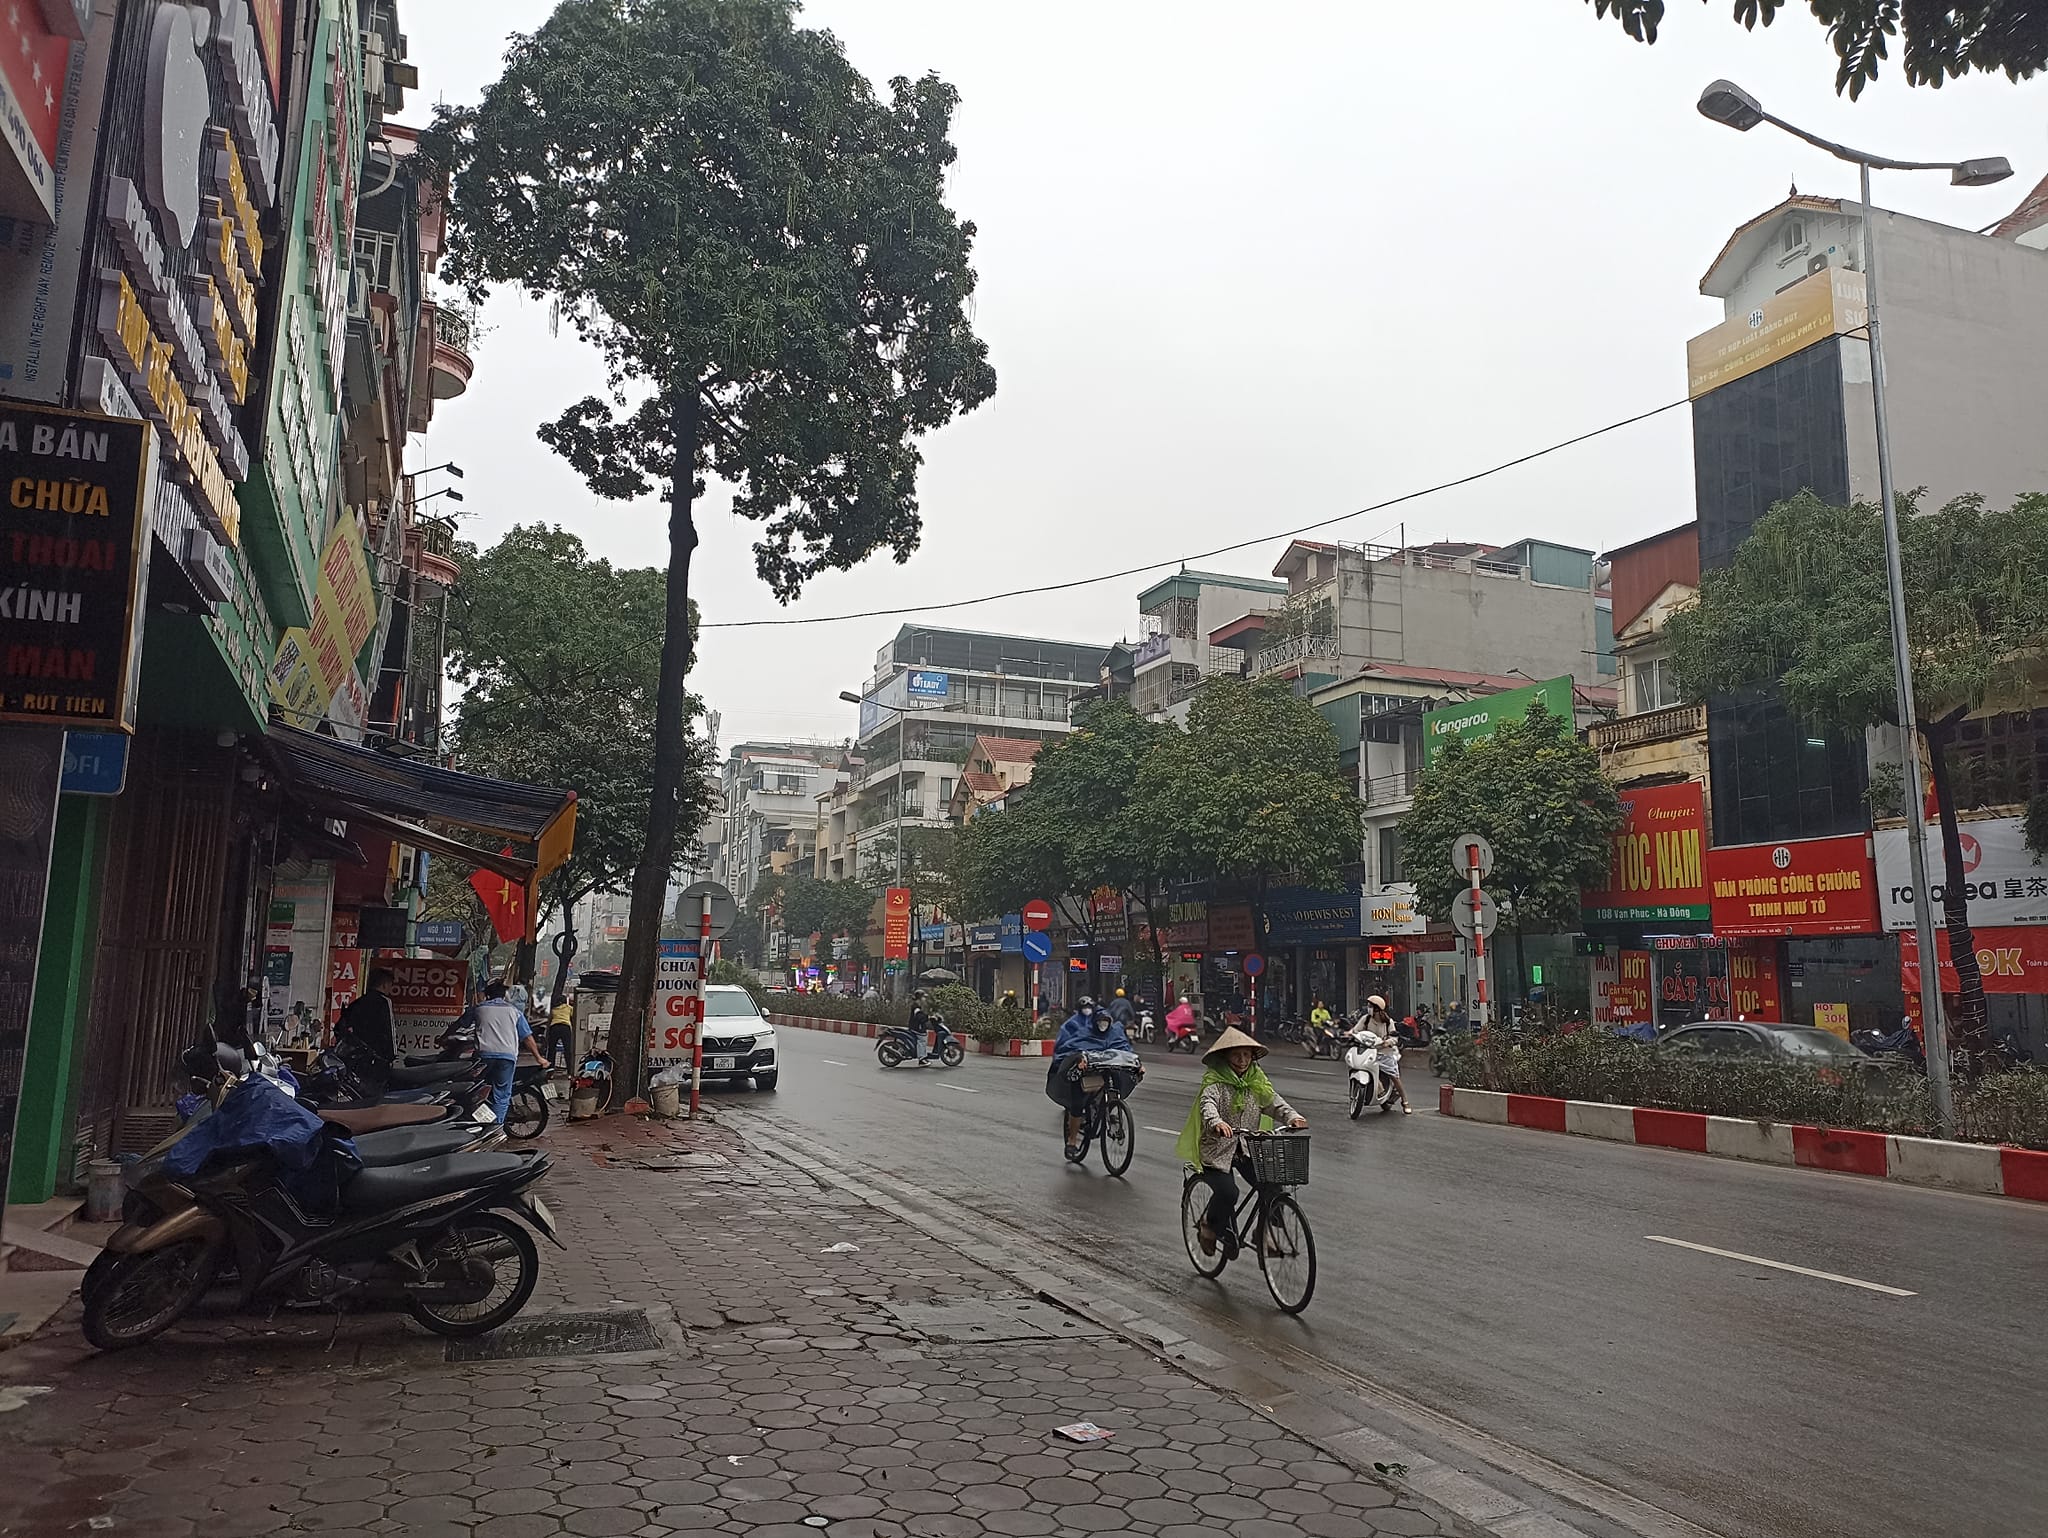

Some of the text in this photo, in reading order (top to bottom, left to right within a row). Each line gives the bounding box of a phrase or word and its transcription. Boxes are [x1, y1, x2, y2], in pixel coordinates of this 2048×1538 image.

[25, 348, 40, 382] INSTALL
[33, 297, 47, 324] RIGHT
[40, 241, 56, 278] REMOVE
[32, 422, 109, 462] BÁN
[10, 476, 110, 516] CHỮA
[1430, 712, 1488, 736] Kangaroo
[1617, 822, 1652, 892] TÓC
[1656, 828, 1702, 890] NAM
[1738, 874, 1778, 896] PHÒNG
[1780, 872, 1814, 894] CÔNG
[1816, 868, 1862, 892] CHỨNG
[2004, 876, 2048, 899] 皇茶
[1784, 898, 1808, 914] NHƯ
[391, 966, 460, 986] NEOS
[1624, 953, 1646, 980] HỚT
[390, 986, 456, 998] OTOR OIL
[1632, 986, 1646, 1010] ÓC
[666, 995, 698, 1017] GA
[1613, 1006, 1633, 1016] 40K
[1824, 1014, 1846, 1023] 30K
